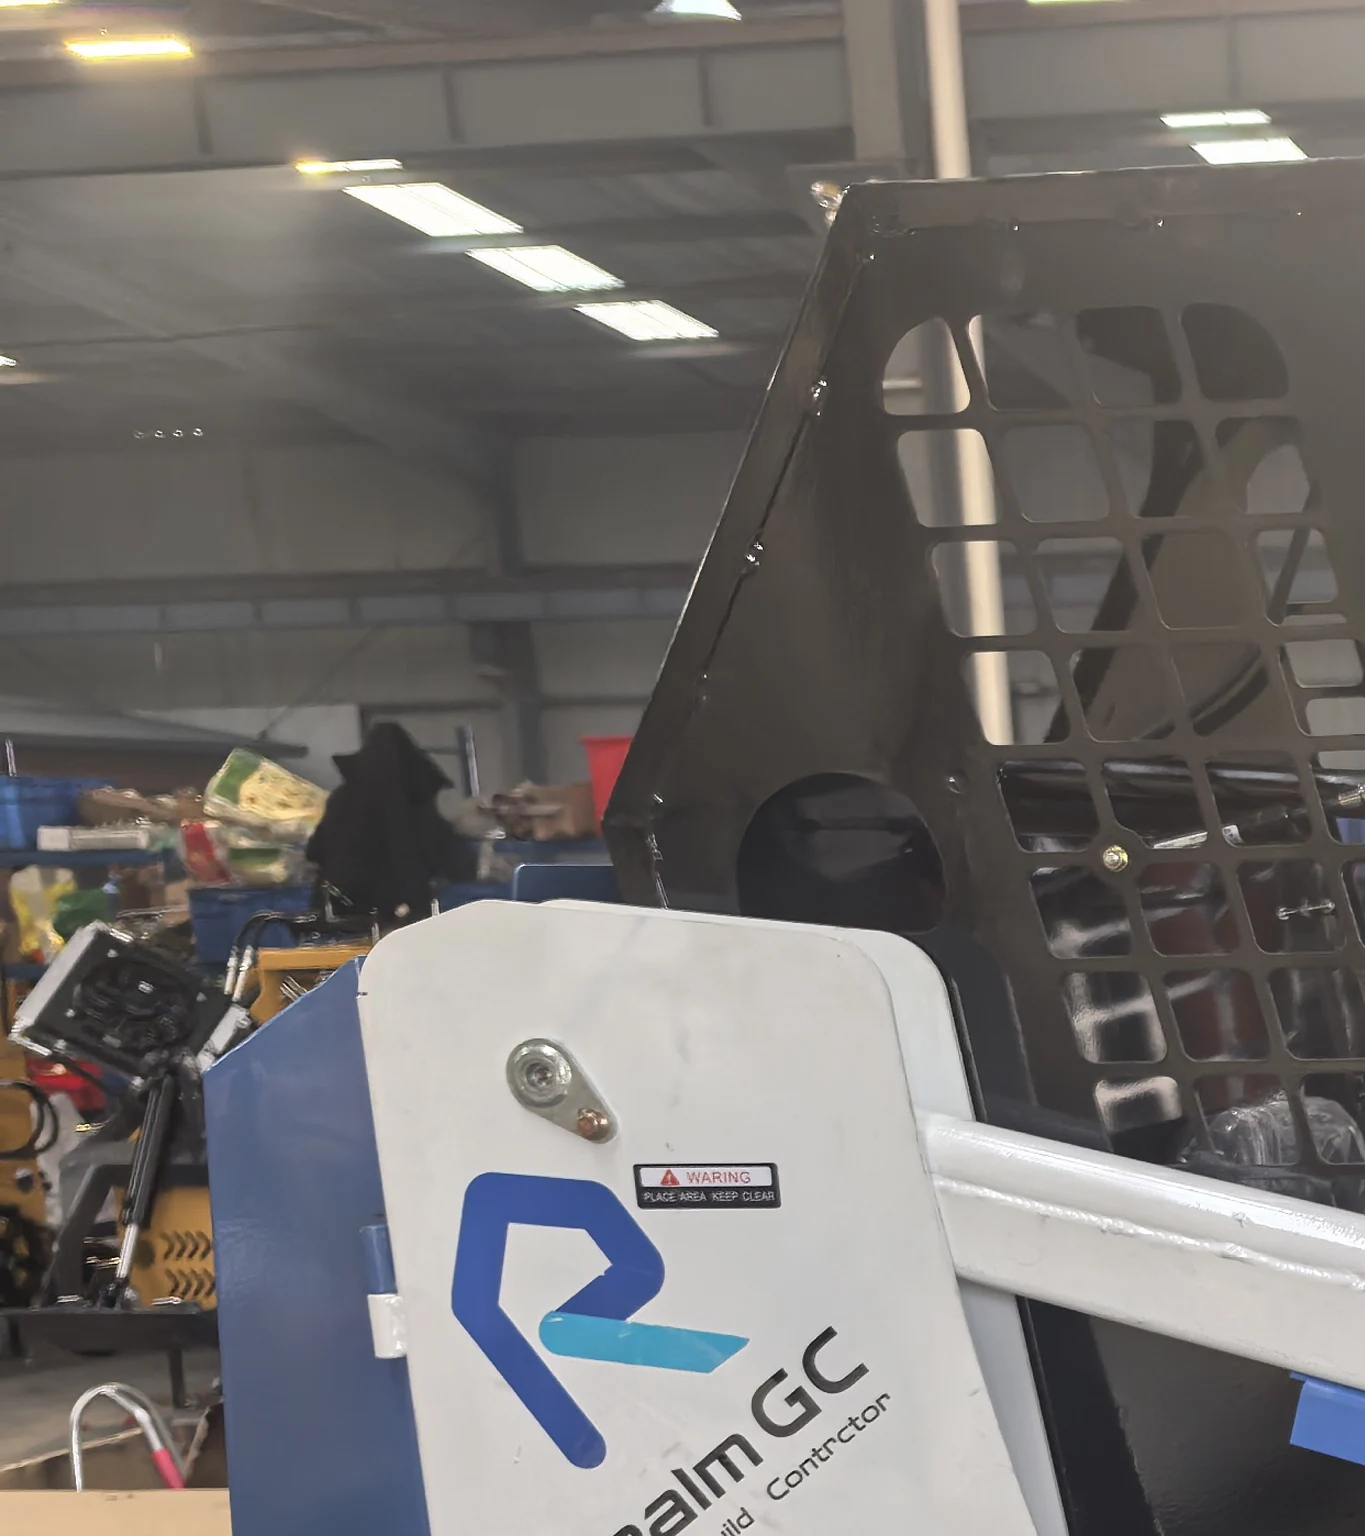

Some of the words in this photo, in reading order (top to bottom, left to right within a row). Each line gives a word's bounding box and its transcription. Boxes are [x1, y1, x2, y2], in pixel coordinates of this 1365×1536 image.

[644, 1191, 677, 1202] PLACE
[679, 1191, 707, 1201] AREA
[711, 1190, 739, 1202] KEEP
[742, 1190, 775, 1202] CLEAR
[686, 1171, 752, 1184] WARING
[752, 1326, 869, 1437] GC
[766, 1393, 891, 1501] Contrctor
